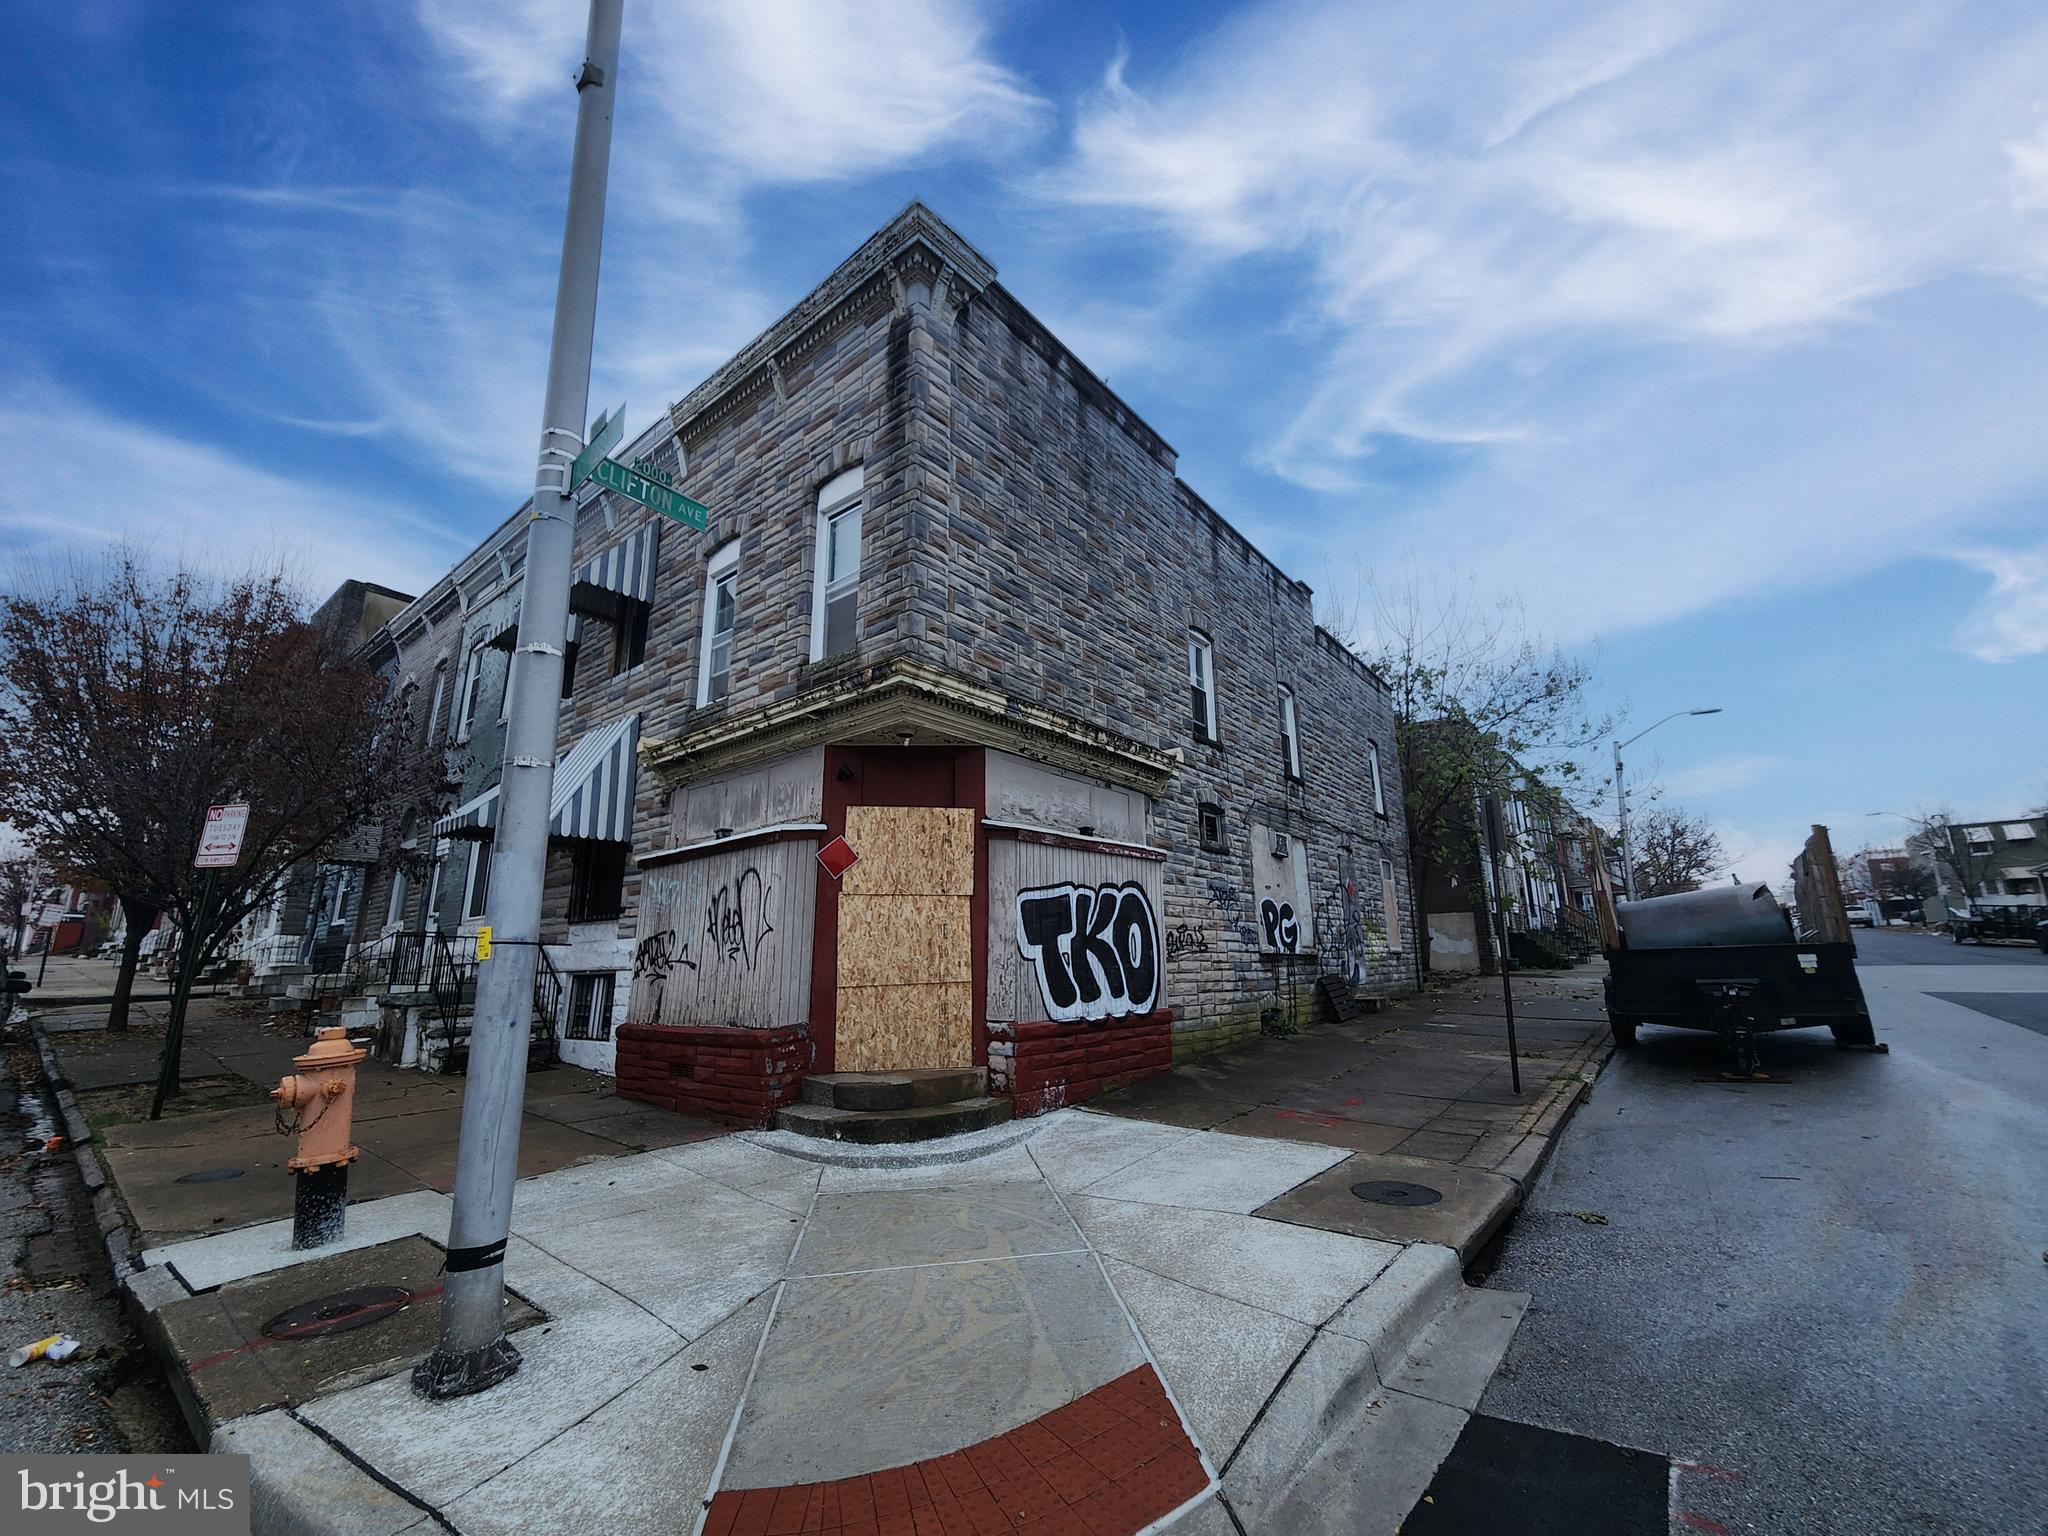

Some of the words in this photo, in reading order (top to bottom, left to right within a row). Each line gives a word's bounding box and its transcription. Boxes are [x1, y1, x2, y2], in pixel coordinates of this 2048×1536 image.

[597, 461, 673, 512] CLIFTON
[678, 503, 702, 521] AVE
[208, 809, 223, 821] NO
[209, 823, 241, 832] TUESDAY
[1017, 881, 1161, 1026] TKO
[1260, 897, 1301, 956] PG
